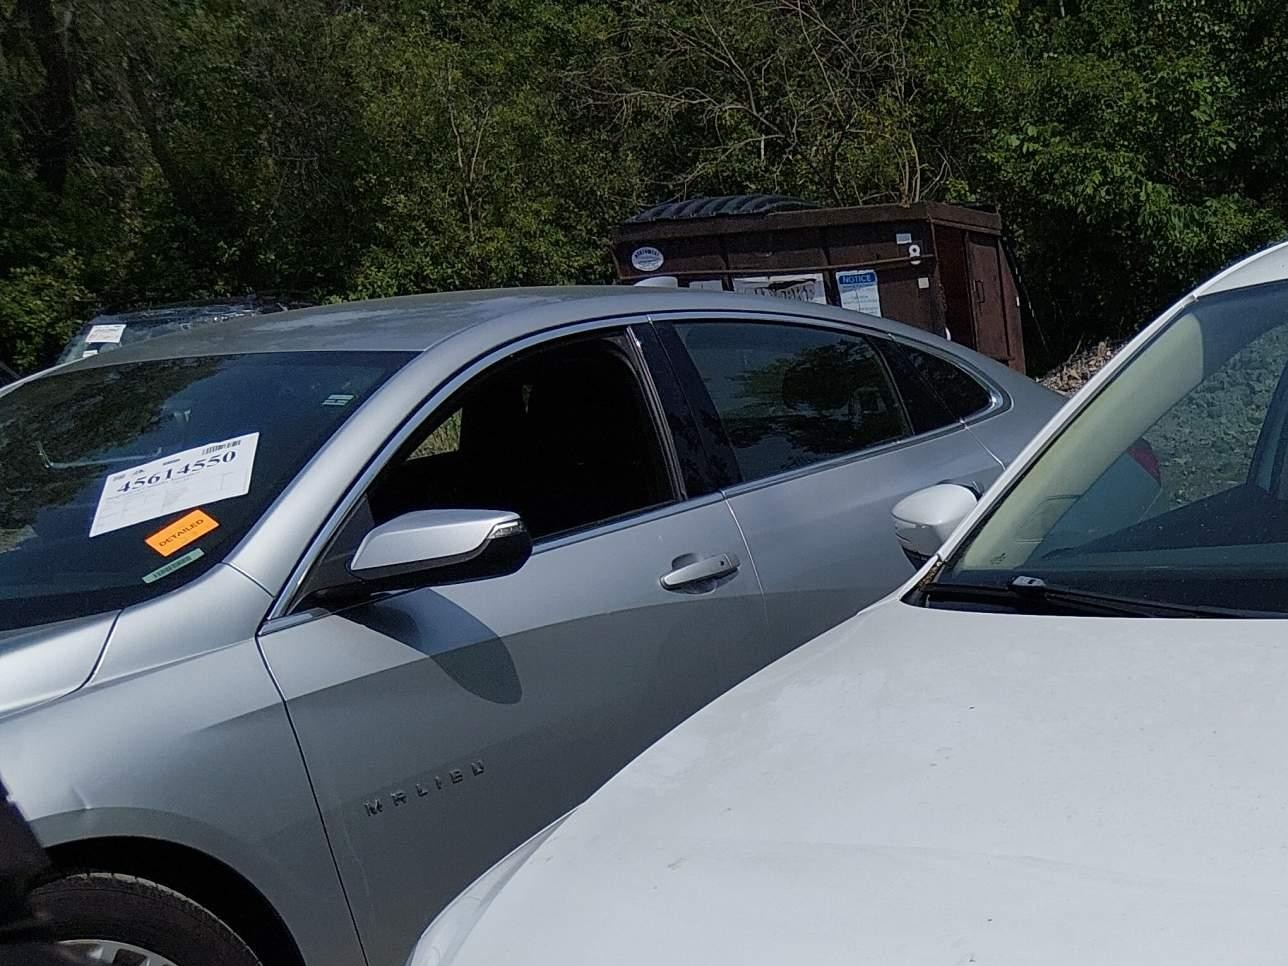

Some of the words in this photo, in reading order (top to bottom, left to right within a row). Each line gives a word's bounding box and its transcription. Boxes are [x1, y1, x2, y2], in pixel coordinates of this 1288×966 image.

[842, 274, 872, 283] NOTICE
[116, 451, 237, 493] 45614550
[159, 518, 205, 547] DETAILED
[363, 759, 485, 817] MALIBU
